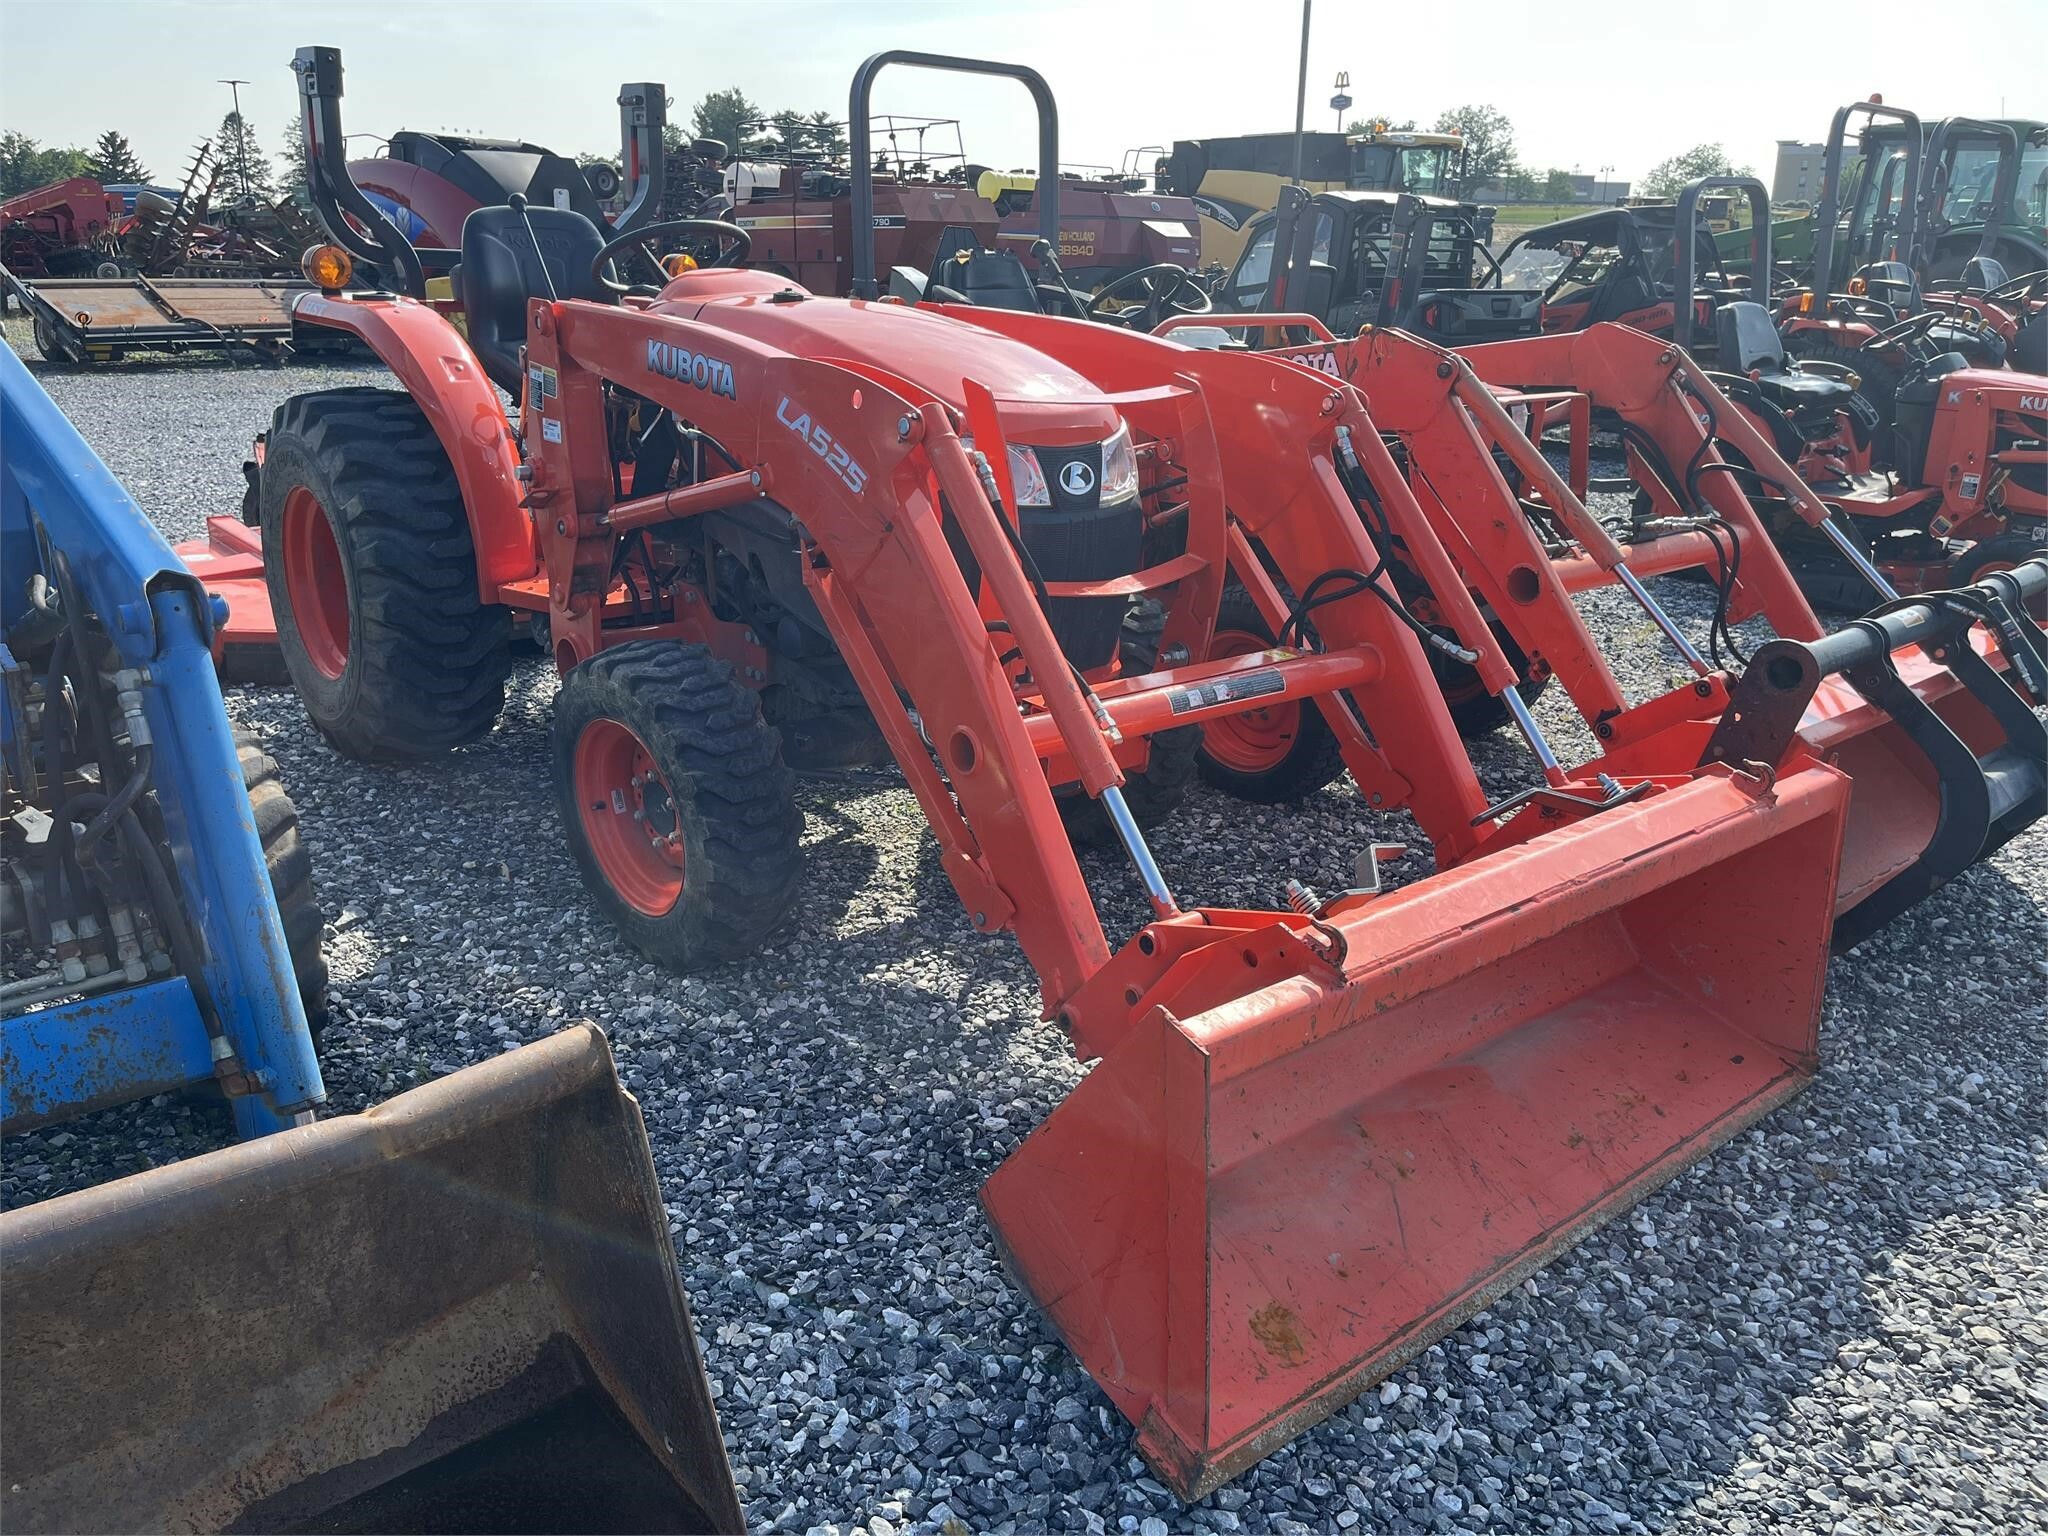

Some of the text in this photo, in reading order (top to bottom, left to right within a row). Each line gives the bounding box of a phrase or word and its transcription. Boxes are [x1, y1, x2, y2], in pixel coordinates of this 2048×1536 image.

[872, 218, 890, 226] 790
[648, 338, 737, 402] KUBOTA
[2020, 395, 2048, 412] KU
[776, 396, 869, 494] LA525
